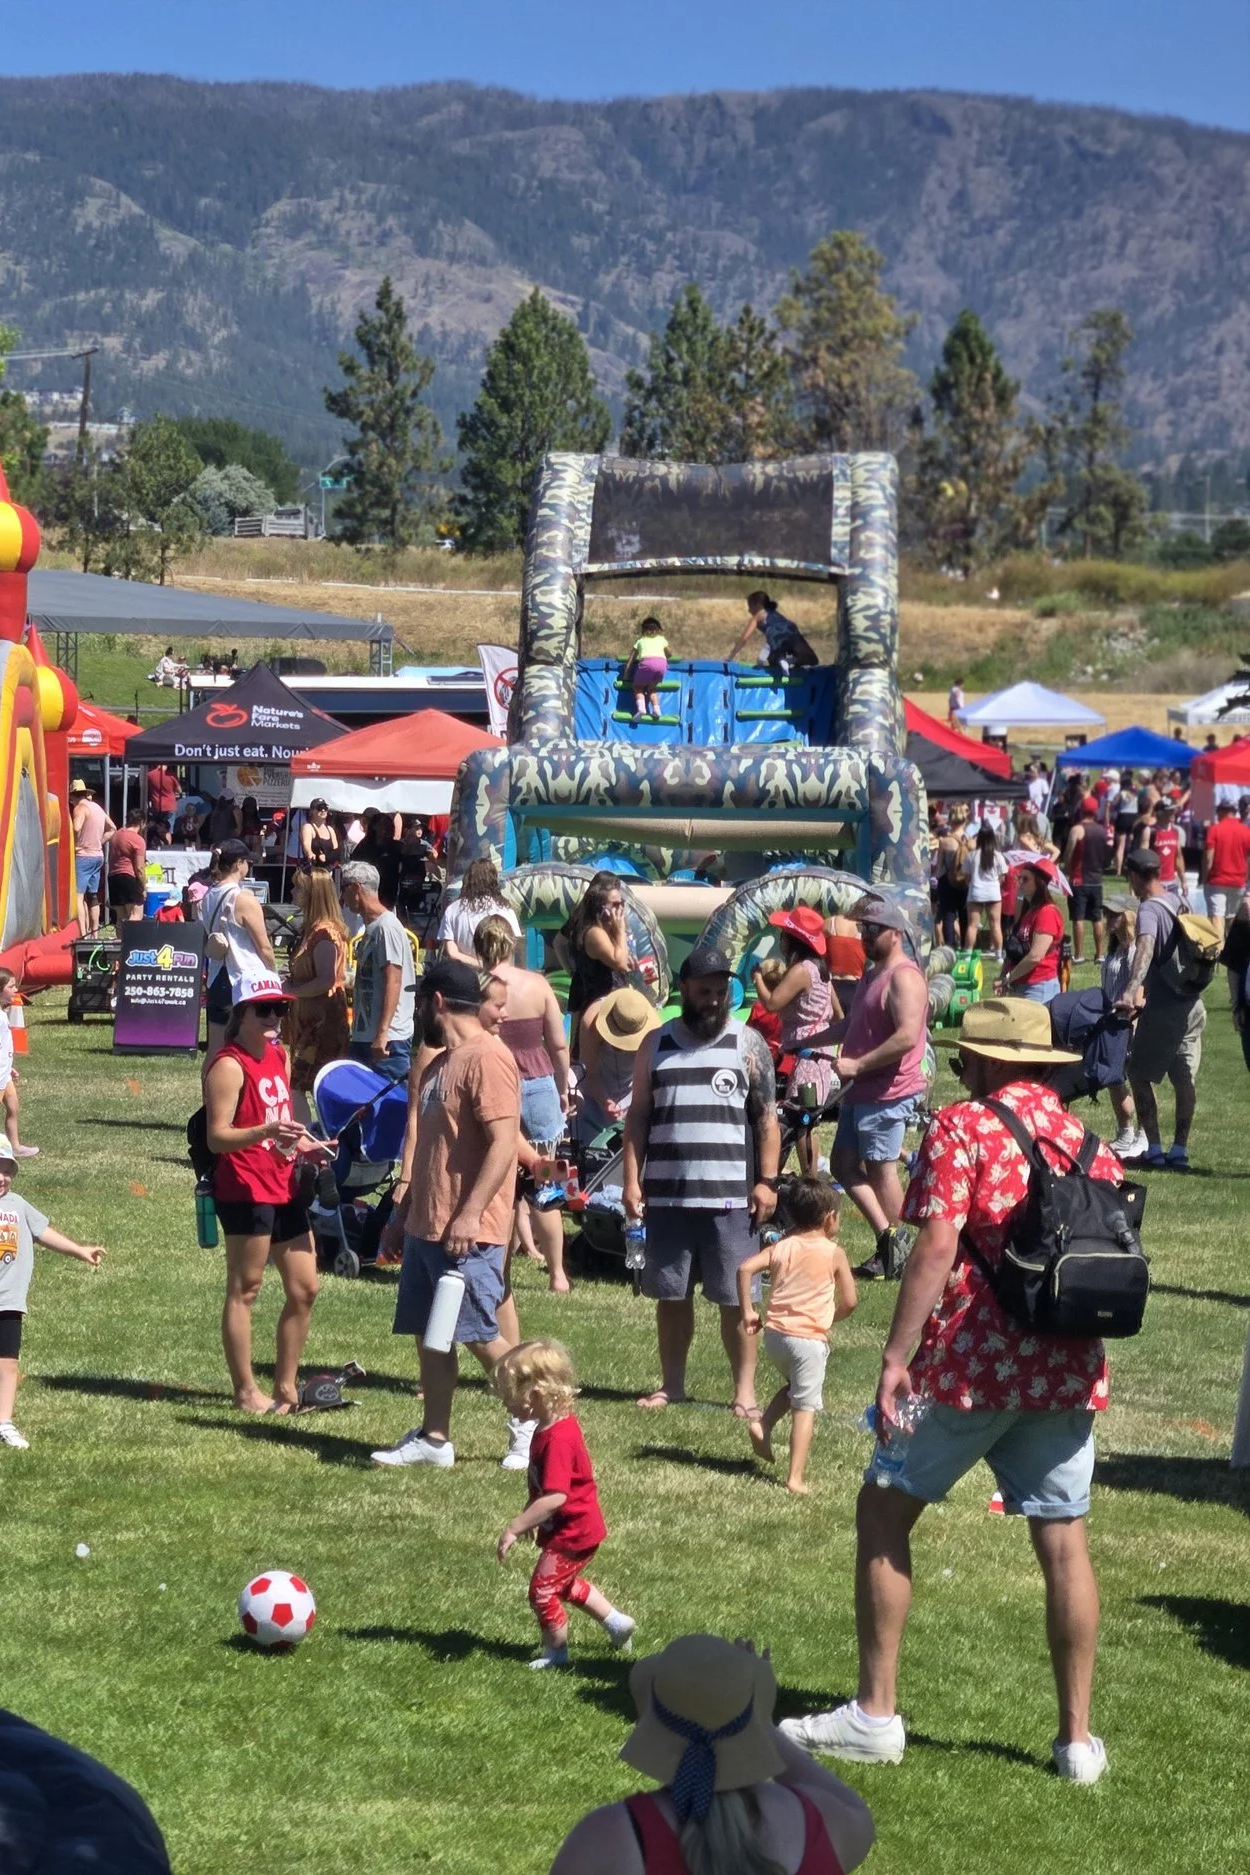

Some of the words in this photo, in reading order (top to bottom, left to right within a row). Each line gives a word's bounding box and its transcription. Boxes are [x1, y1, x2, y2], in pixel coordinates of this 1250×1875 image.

[251, 712, 280, 722] Fare
[252, 705, 304, 718] Nature's
[251, 720, 301, 730] Markets
[174, 743, 212, 757] Don't
[213, 743, 240, 760] just
[243, 745, 268, 758] eat.
[272, 745, 310, 759] Nou
[125, 973, 153, 981] PARTY
[155, 974, 195, 983] RENTALS
[124, 985, 195, 998] 250-863-7858
